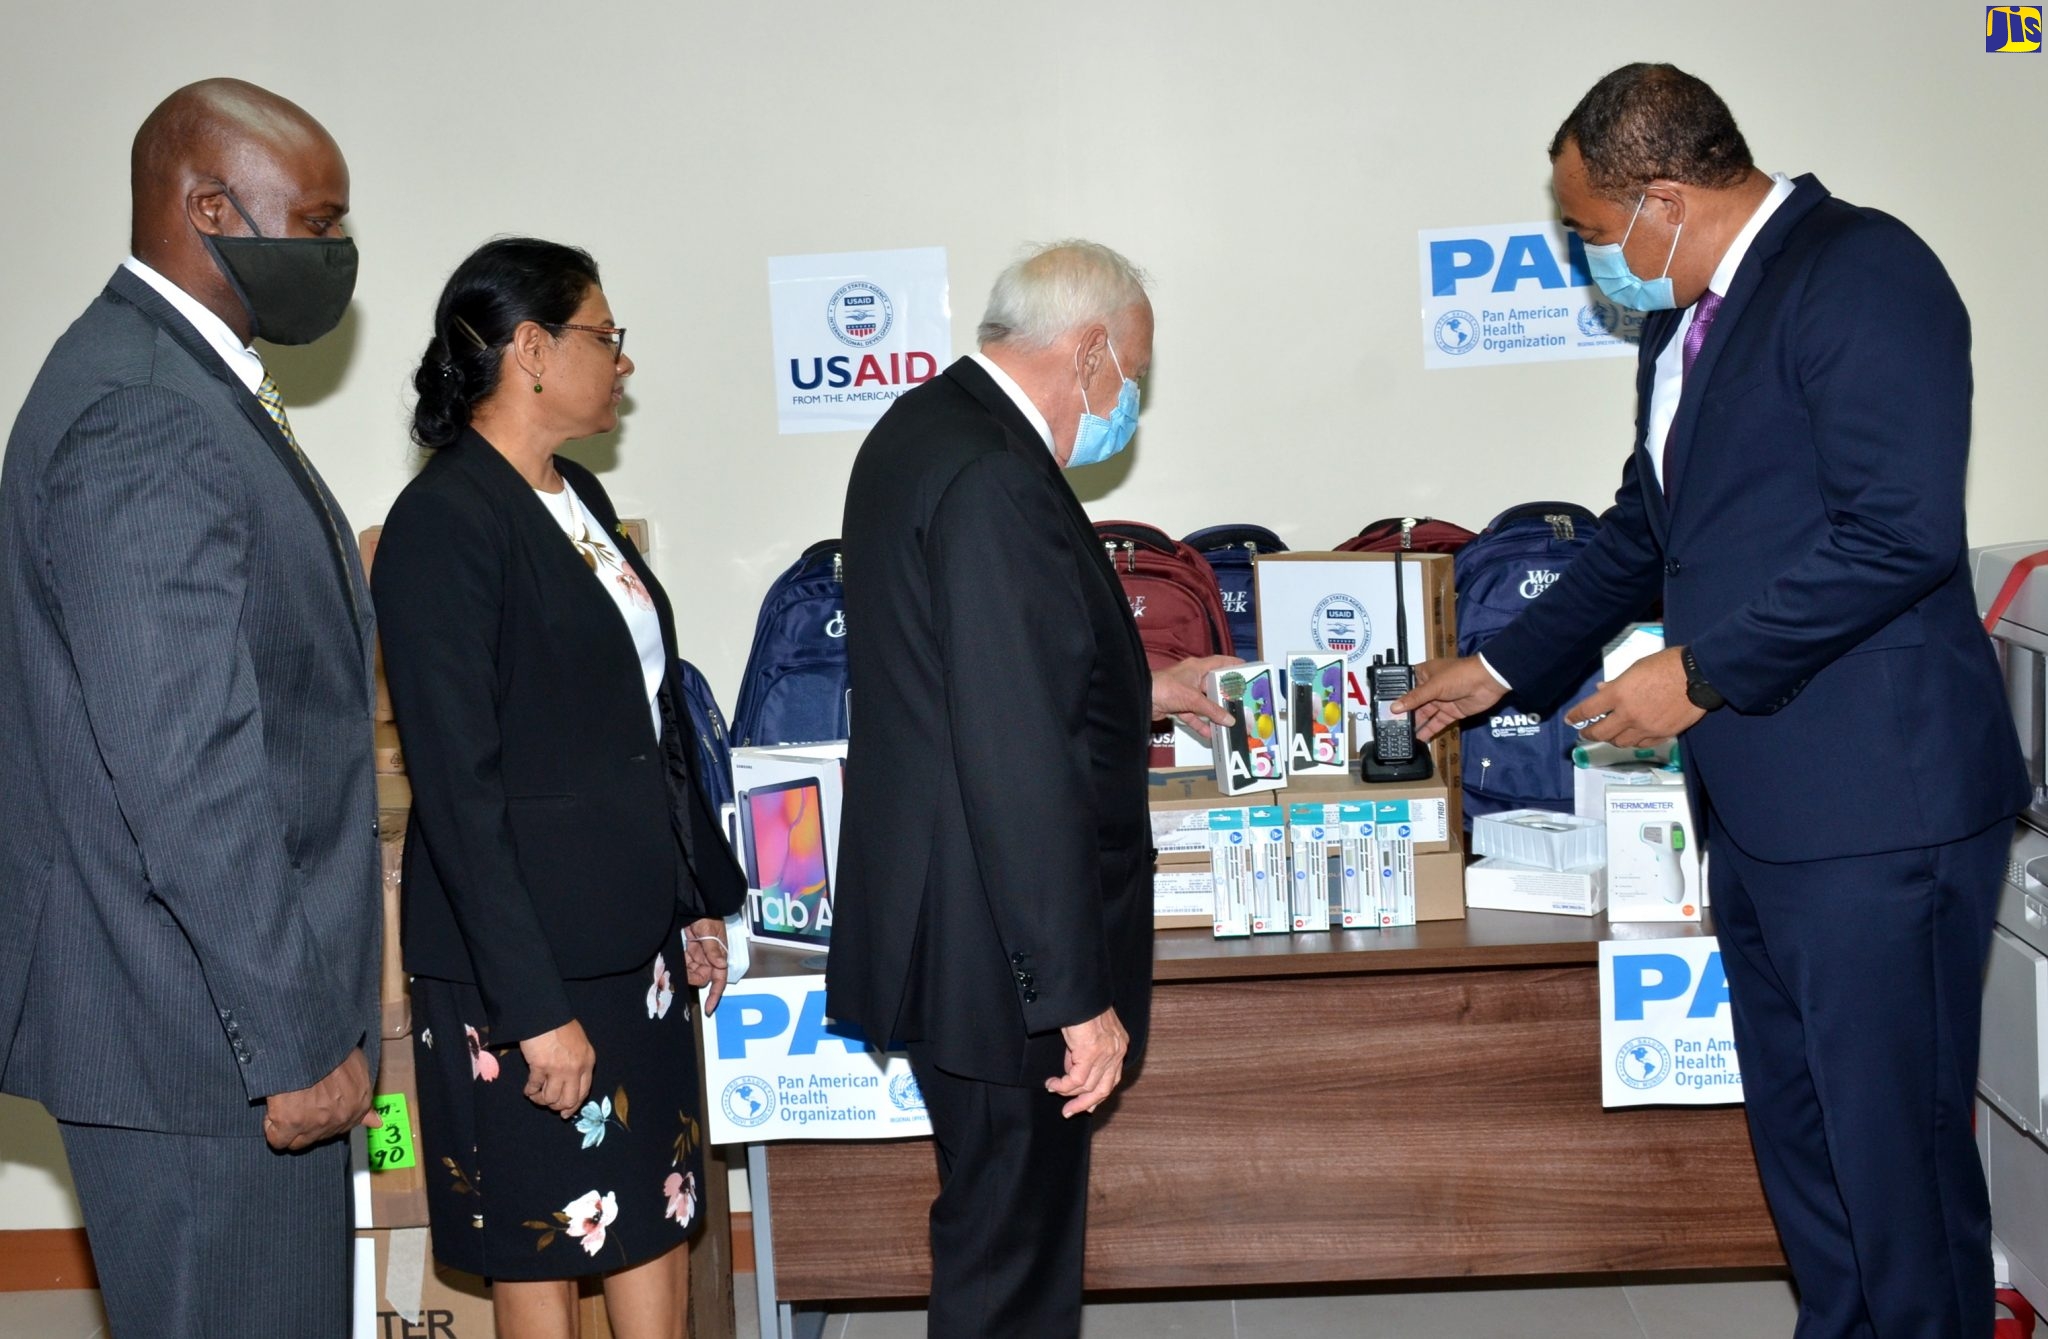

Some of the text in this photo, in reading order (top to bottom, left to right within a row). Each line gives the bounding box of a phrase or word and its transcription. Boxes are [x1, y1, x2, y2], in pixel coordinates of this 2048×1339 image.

[846, 297, 873, 305] USAID
[1482, 307, 1569, 322] Pan American
[1483, 322, 1525, 336] Health
[1483, 334, 1566, 352] Organization
[790, 351, 937, 390] USAID
[792, 395, 821, 405] FROM
[823, 393, 844, 403] THE
[846, 389, 900, 402] AMERICAN
[1328, 610, 1352, 618] USAID
[1490, 713, 1541, 728] PAHO
[1291, 733, 1344, 762] A51
[1229, 744, 1281, 779] A51
[1610, 802, 1674, 810] THERMOMETER
[748, 889, 808, 929] Tab
[1675, 1038, 1702, 1052] Pan
[1675, 1053, 1726, 1070] Health
[778, 1073, 879, 1089] Pan American
[780, 1089, 828, 1105] Health
[781, 1105, 876, 1124] Organization
[385, 1125, 401, 1144] 3
